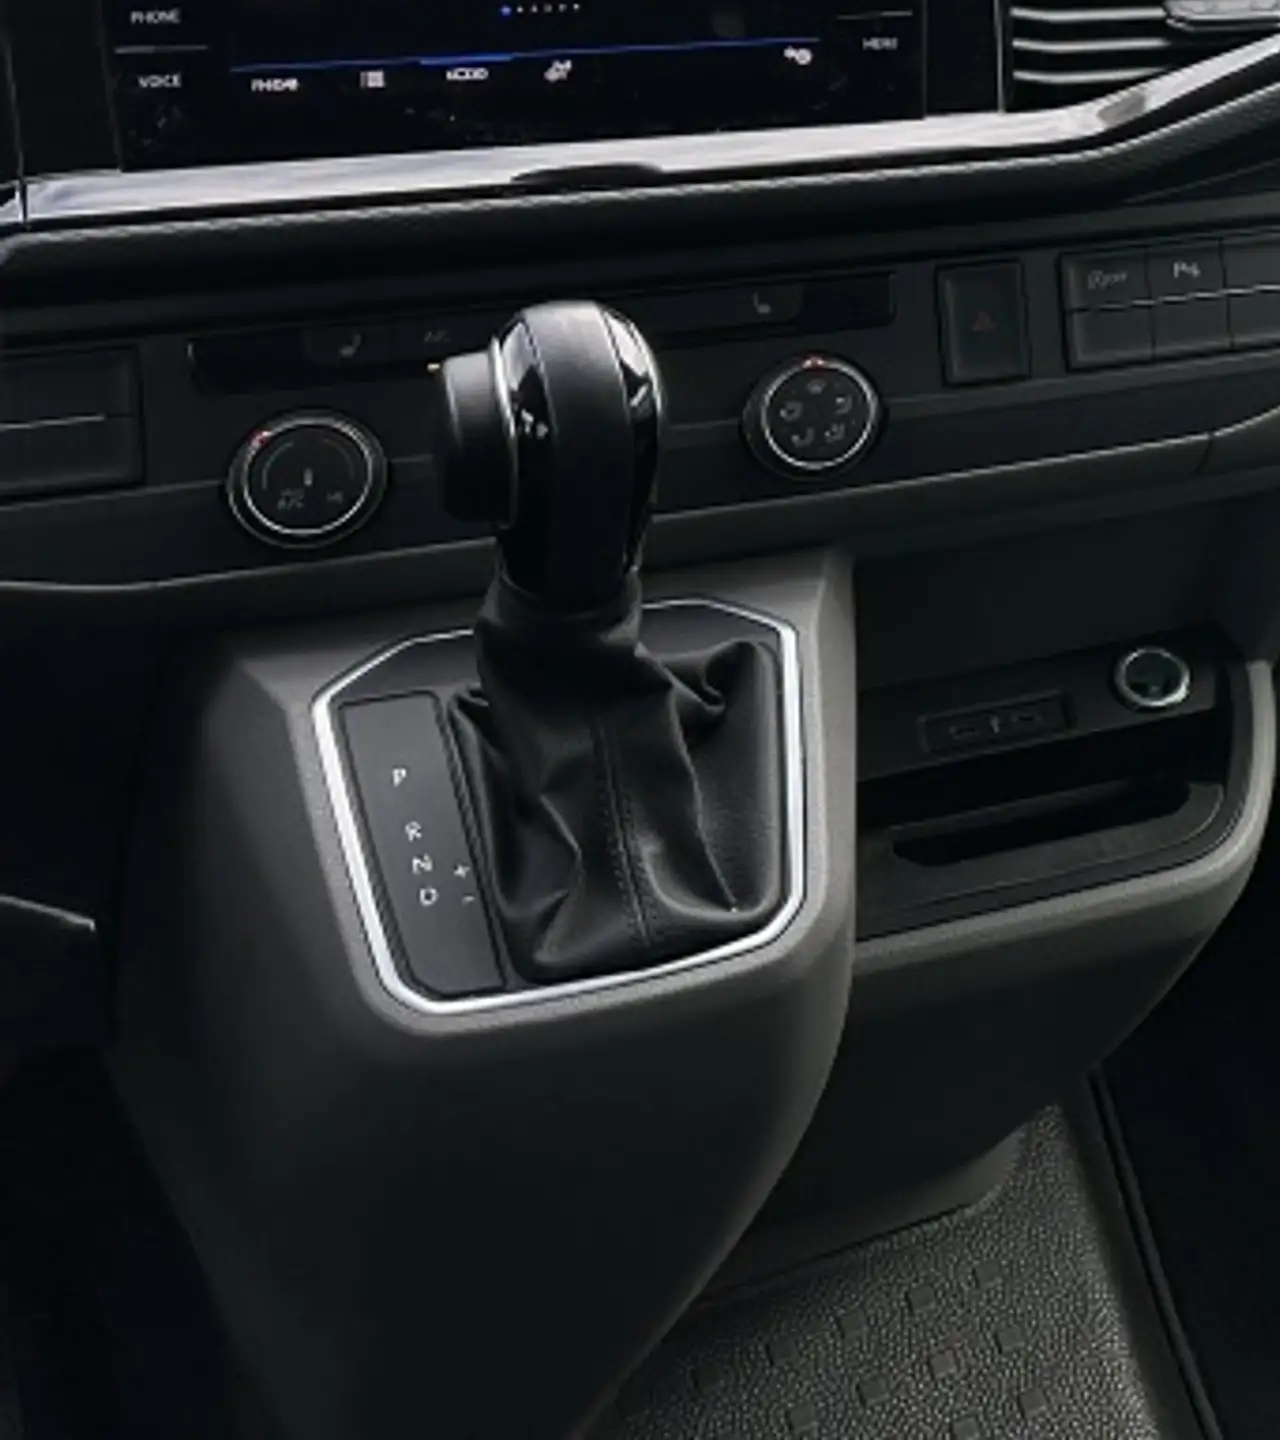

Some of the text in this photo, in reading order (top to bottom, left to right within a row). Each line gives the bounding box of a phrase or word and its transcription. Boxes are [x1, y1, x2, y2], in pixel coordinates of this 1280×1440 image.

[130, 7, 181, 25] PHONE
[137, 71, 182, 88] VOICE
[392, 767, 440, 907] P R N D
